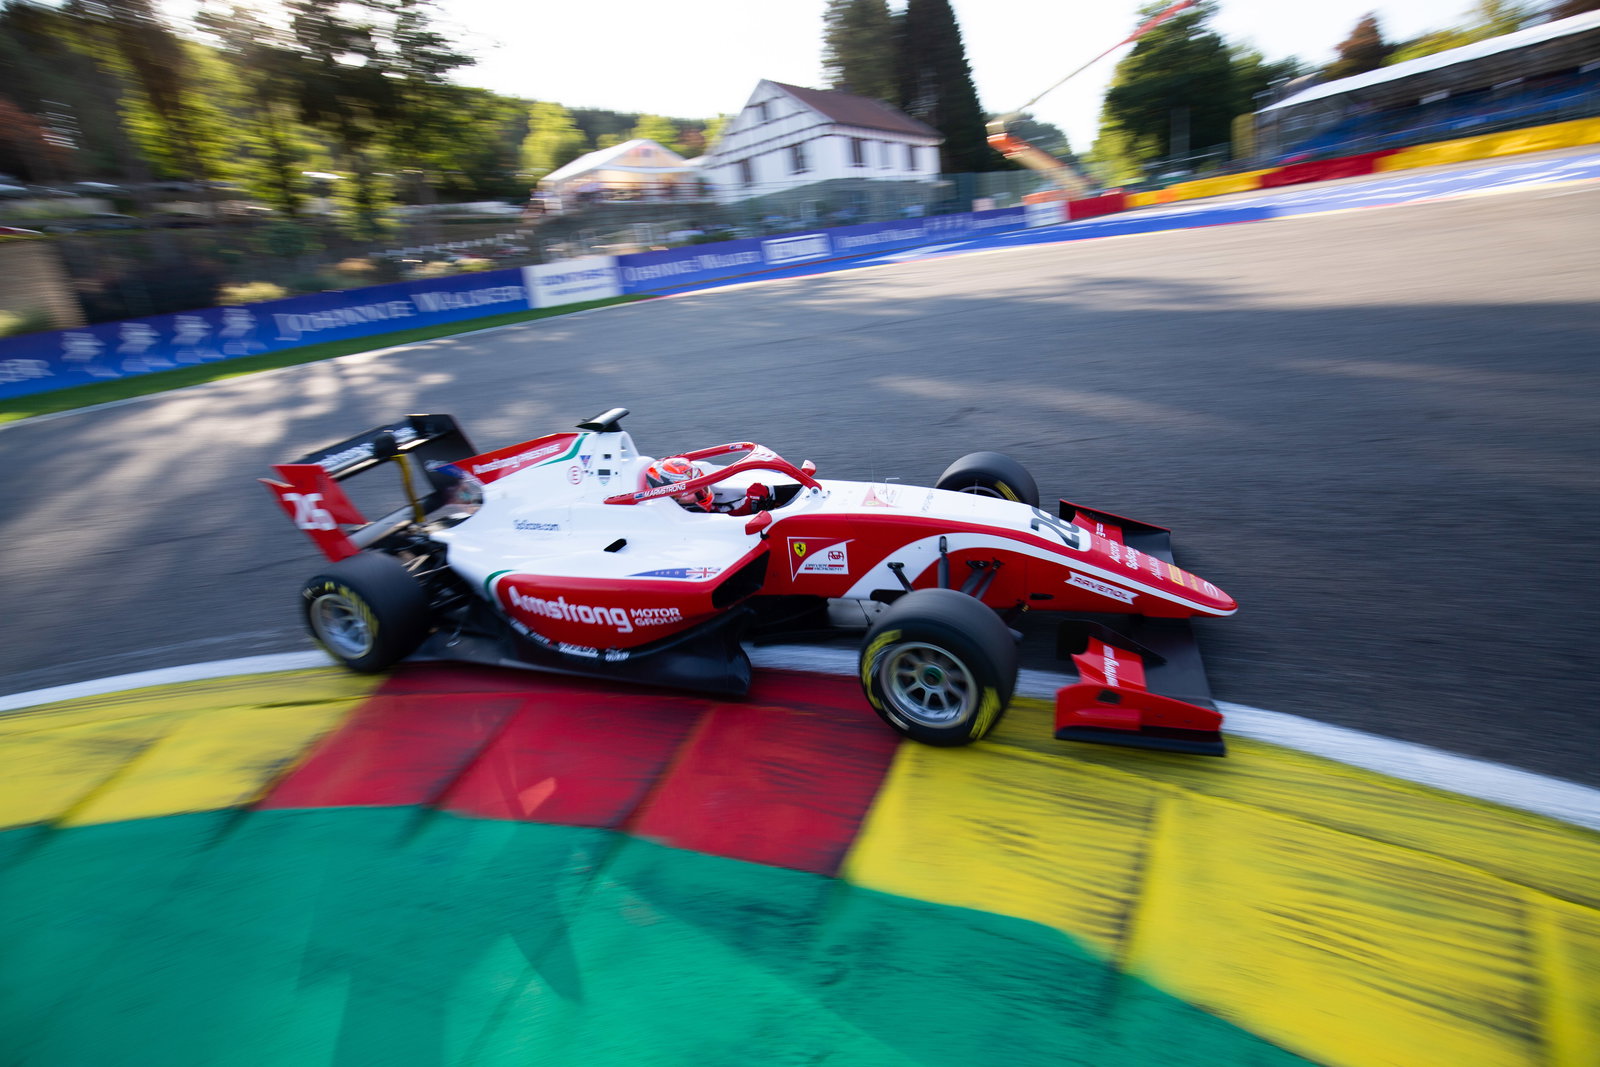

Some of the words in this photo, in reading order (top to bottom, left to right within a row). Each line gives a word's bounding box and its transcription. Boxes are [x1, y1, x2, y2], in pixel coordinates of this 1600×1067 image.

[1073, 576, 1129, 600] RAVENOL
[508, 585, 634, 633] Armstrong
[630, 607, 680, 619] MOTOR
[634, 615, 683, 627] GROUP
